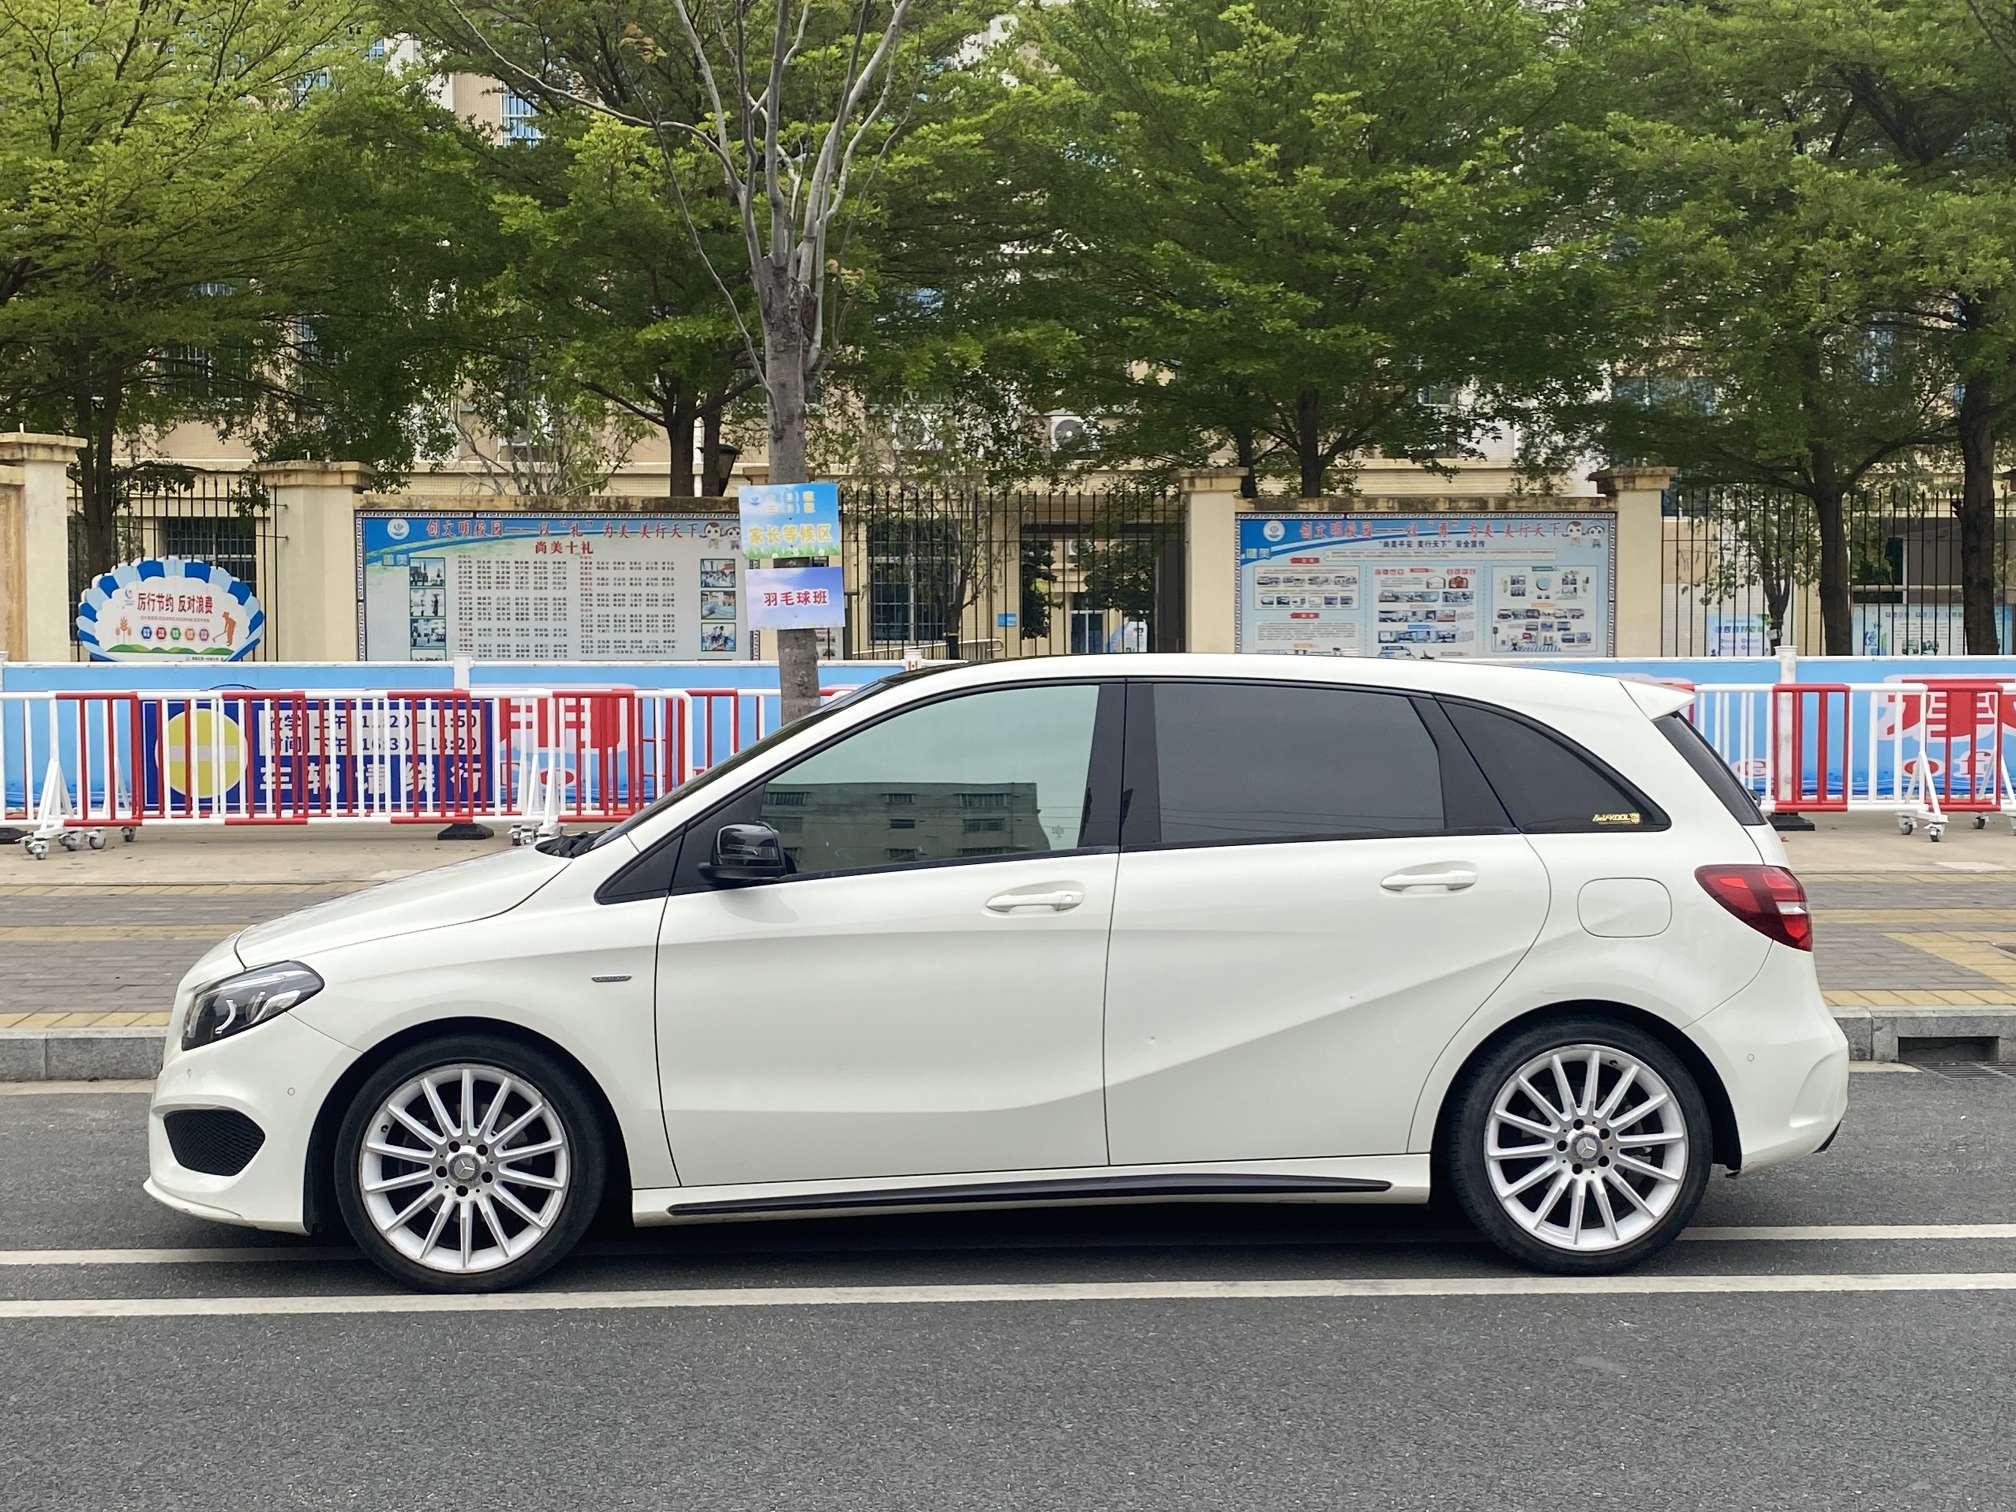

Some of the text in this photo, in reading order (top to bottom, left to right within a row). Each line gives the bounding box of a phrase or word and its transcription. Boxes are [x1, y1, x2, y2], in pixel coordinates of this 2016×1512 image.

[535, 540, 594, 555] 尚美十礼
[137, 592, 214, 614] 厉行节约 反对浪费
[763, 589, 828, 607] 羽毛球班
